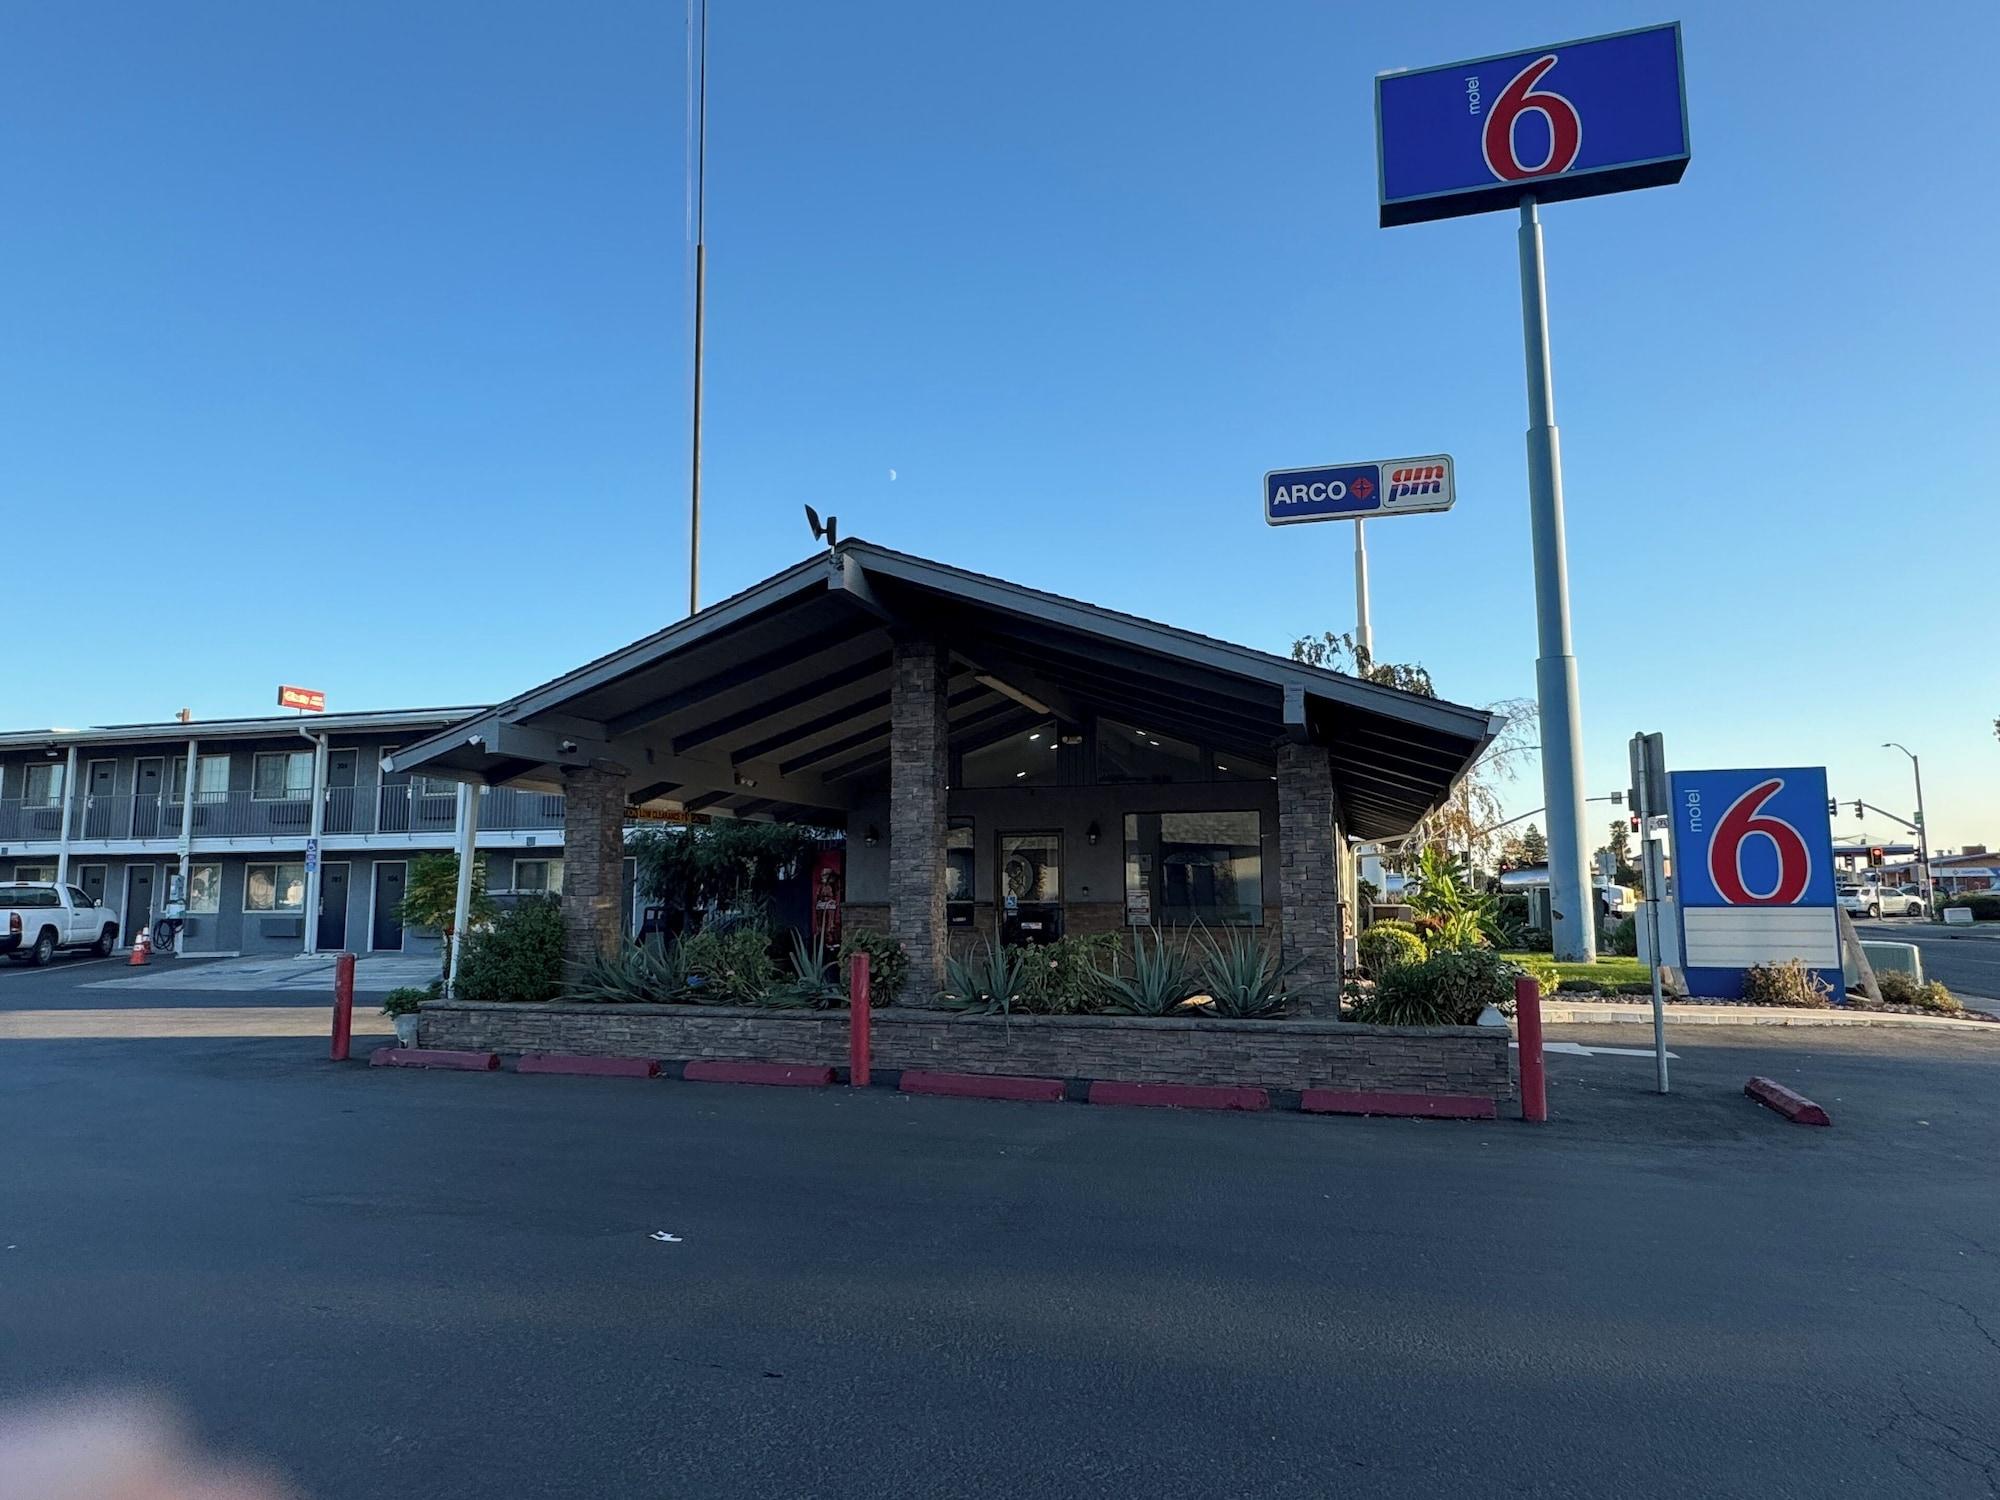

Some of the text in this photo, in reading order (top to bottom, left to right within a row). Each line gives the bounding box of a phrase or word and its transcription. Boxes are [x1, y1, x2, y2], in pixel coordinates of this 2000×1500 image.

[1465, 54, 1582, 182] motel 6
[1392, 464, 1444, 483] am
[1273, 481, 1347, 505] ARCO
[1388, 480, 1441, 502] pm
[1684, 777, 1812, 904] motel 6
